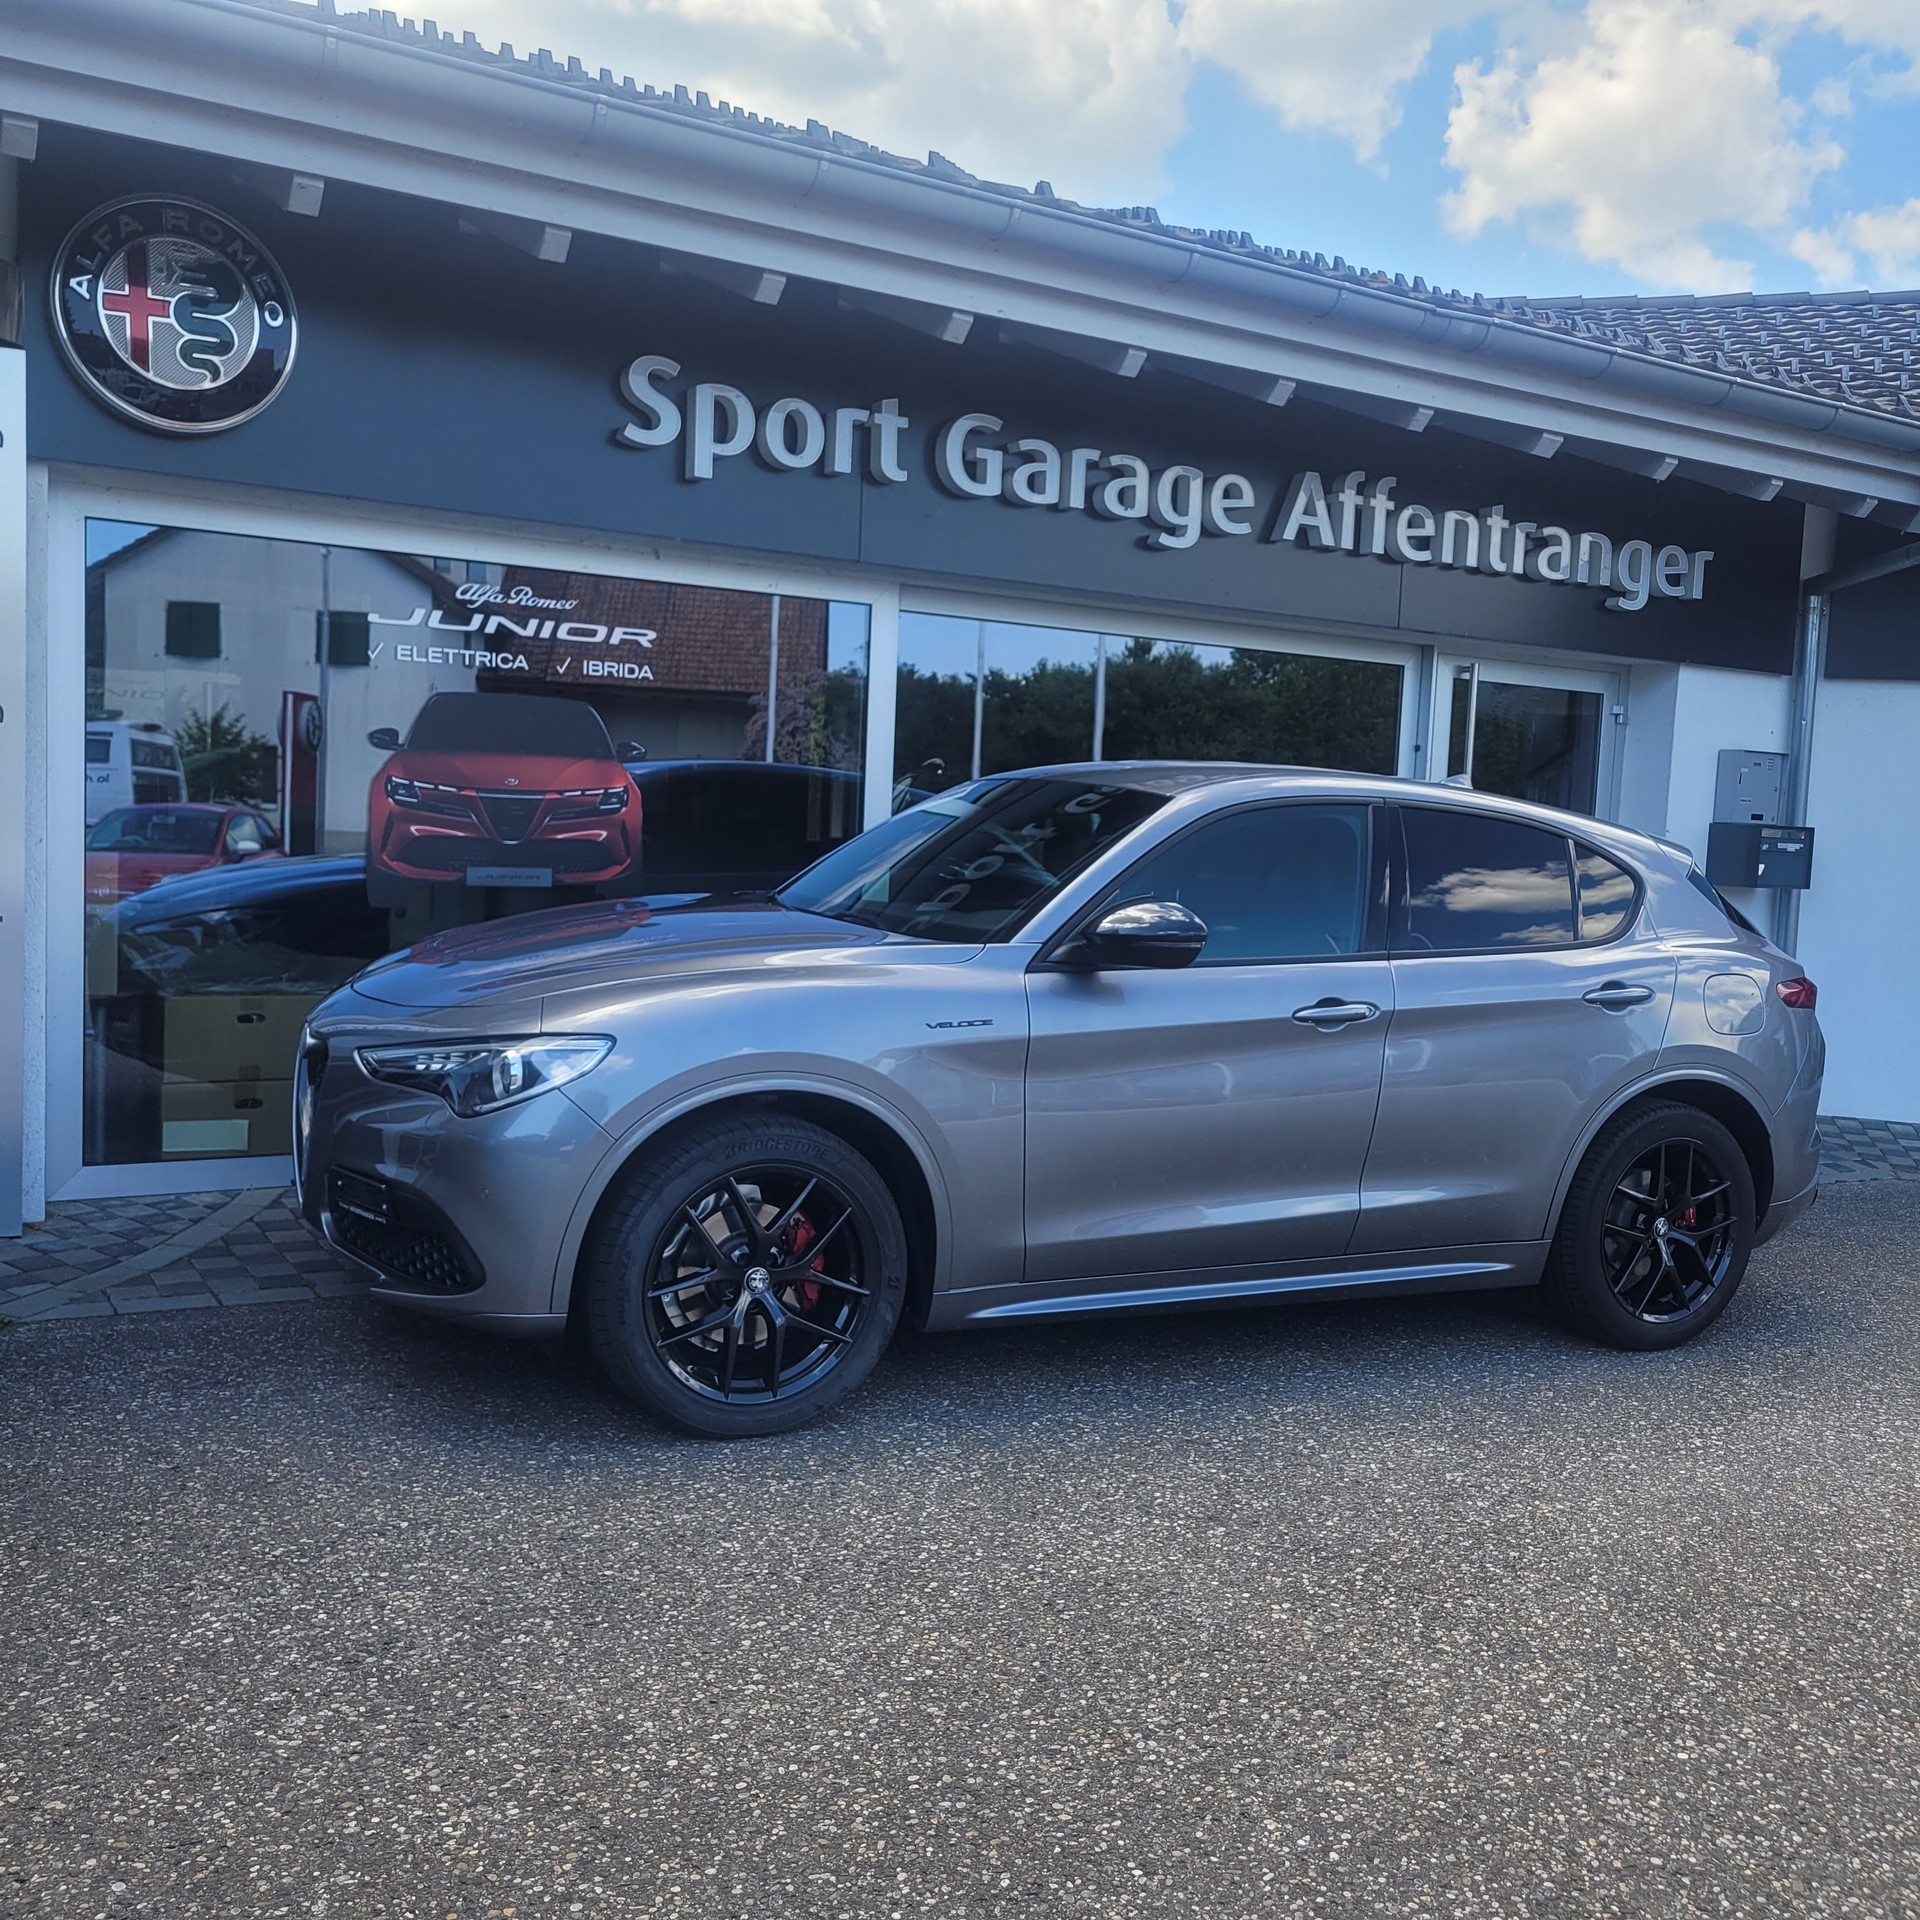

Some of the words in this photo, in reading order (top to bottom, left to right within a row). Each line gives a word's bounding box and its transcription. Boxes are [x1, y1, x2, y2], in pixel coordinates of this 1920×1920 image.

[69, 213, 144, 300] ALFA
[166, 209, 284, 328] ROMEO
[619, 354, 909, 481] Sport
[941, 412, 1256, 549] Garage
[1281, 470, 1715, 611] Affentranger
[455, 582, 507, 609] Alfa
[507, 586, 579, 610] Romeo
[367, 607, 657, 648] JUNIOR
[396, 644, 529, 670] ELETTRICA
[583, 660, 654, 680] IBRIDA
[925, 1019, 994, 1029] VELOCE
